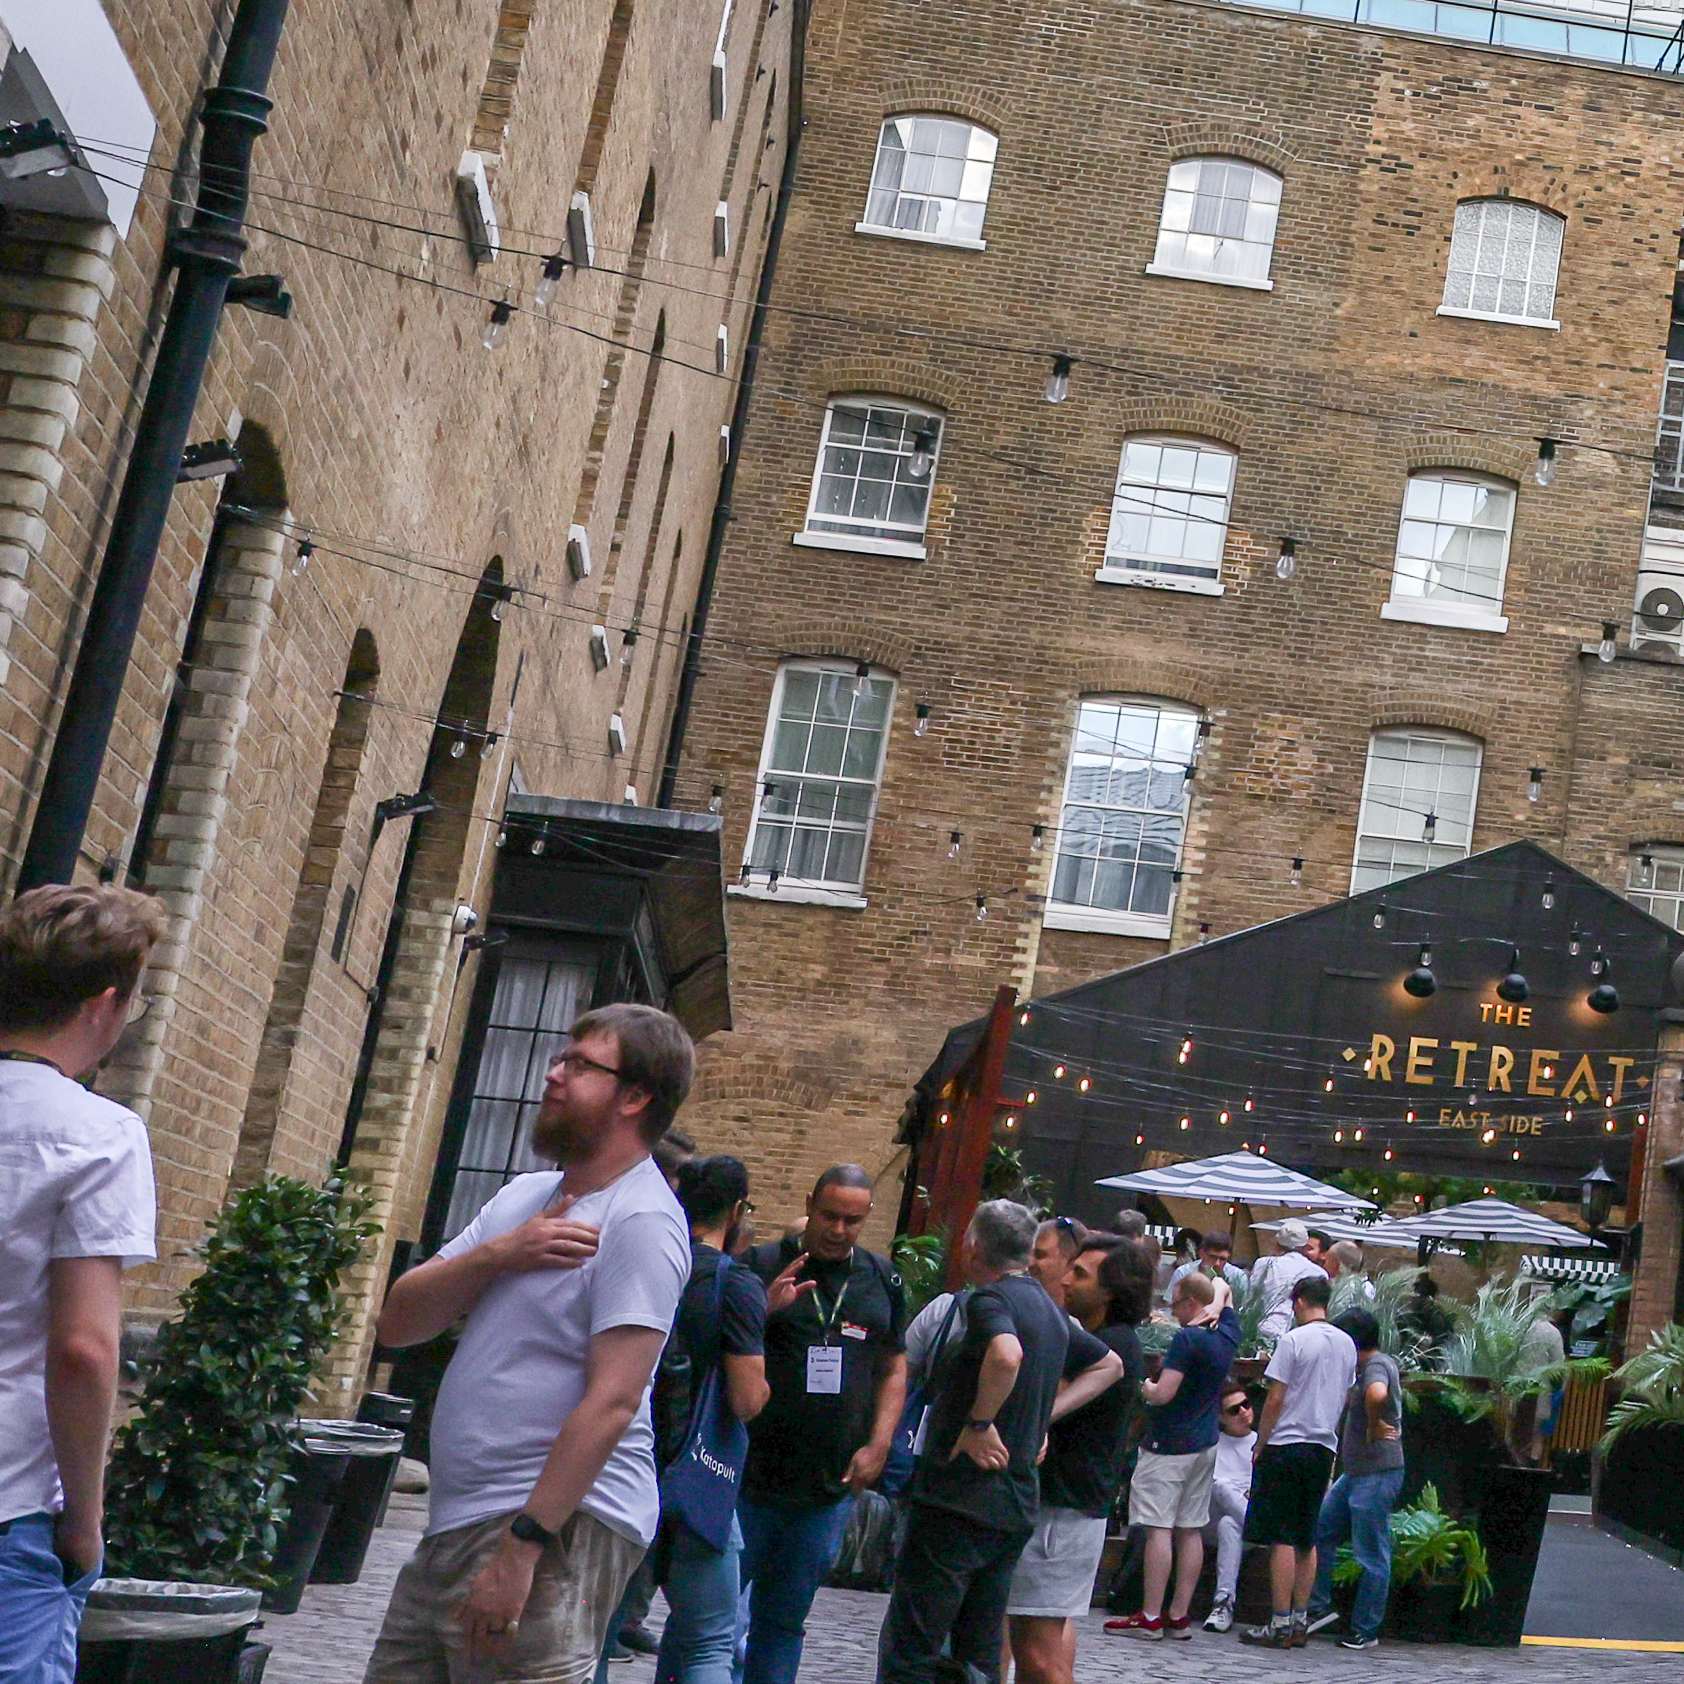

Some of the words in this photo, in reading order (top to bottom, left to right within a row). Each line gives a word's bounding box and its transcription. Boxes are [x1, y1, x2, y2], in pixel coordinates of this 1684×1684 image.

[1480, 1003, 1532, 1027] THE
[1367, 1033, 1635, 1103] RETREAT
[1439, 1108, 1491, 1129] EAST
[1500, 1114, 1543, 1135] SIDE
[700, 1446, 735, 1483] Katapult
